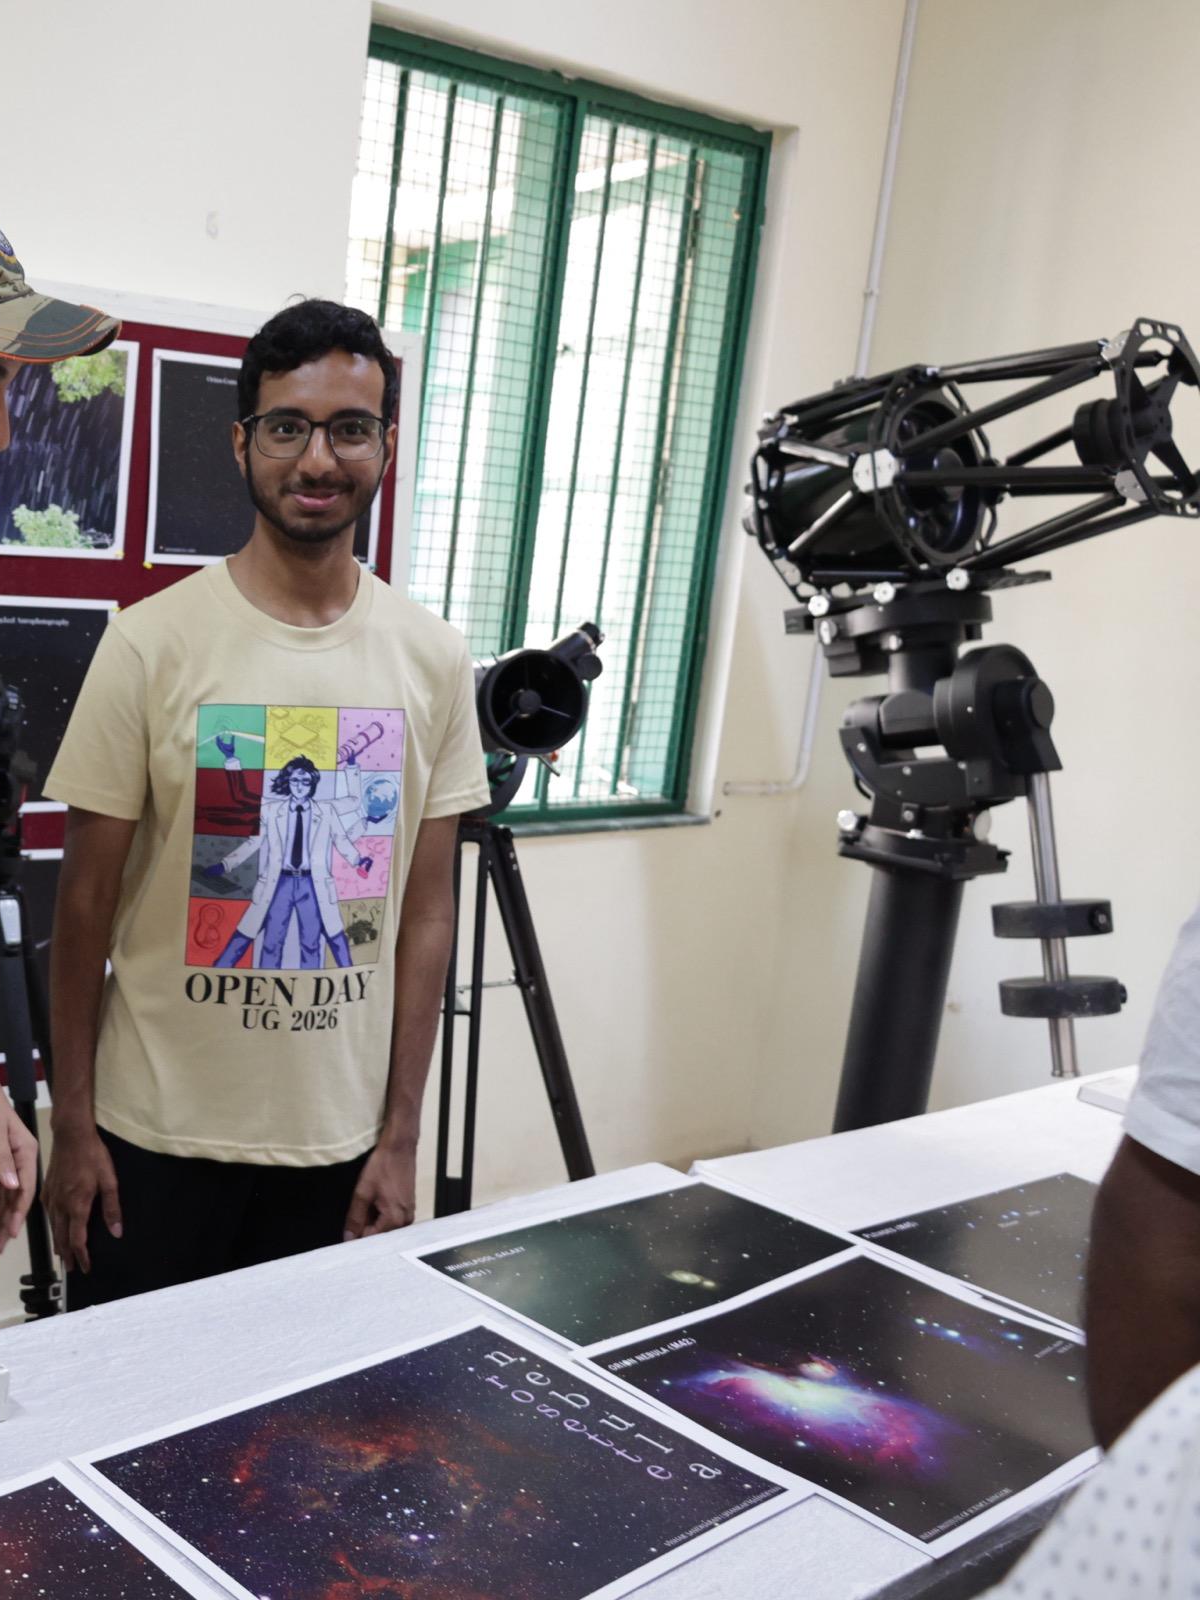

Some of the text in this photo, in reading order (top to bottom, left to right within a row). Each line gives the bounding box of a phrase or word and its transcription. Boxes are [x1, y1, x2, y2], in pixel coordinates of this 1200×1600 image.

[185, 970, 375, 1007] OPEN DAY
[243, 1008, 338, 1032] UG 2026
[608, 1337, 697, 1371] ORION NEBULA (M42)
[486, 1375, 672, 1480] rosette
